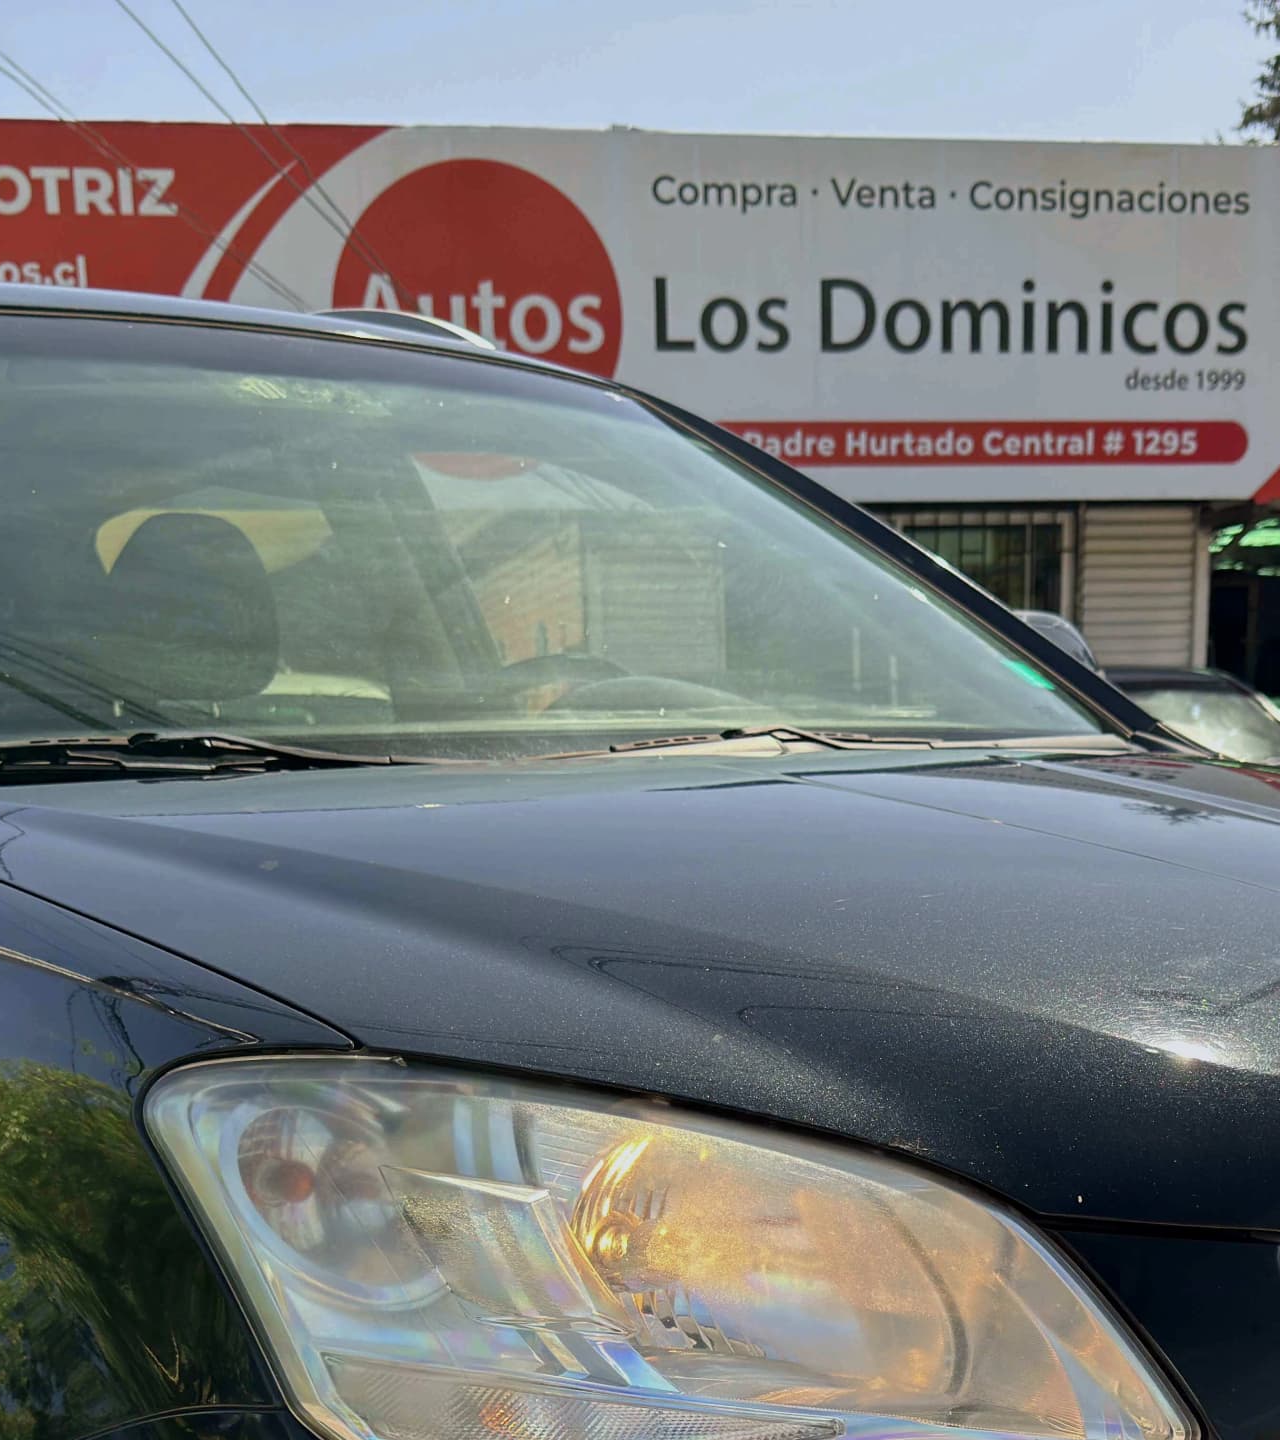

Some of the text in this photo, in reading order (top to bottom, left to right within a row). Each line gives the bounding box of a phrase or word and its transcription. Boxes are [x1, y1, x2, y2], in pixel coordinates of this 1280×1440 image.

[651, 174, 1252, 218] Compra Venta Consignaciones
[361, 272, 606, 354] Autos
[652, 276, 1250, 356] Los Dominicos
[1124, 370, 1247, 392] desde 1999
[845, 430, 975, 457] Hurtado
[982, 430, 1096, 457] Central
[1104, 432, 1124, 455] #
[1132, 430, 1198, 456] 1295
